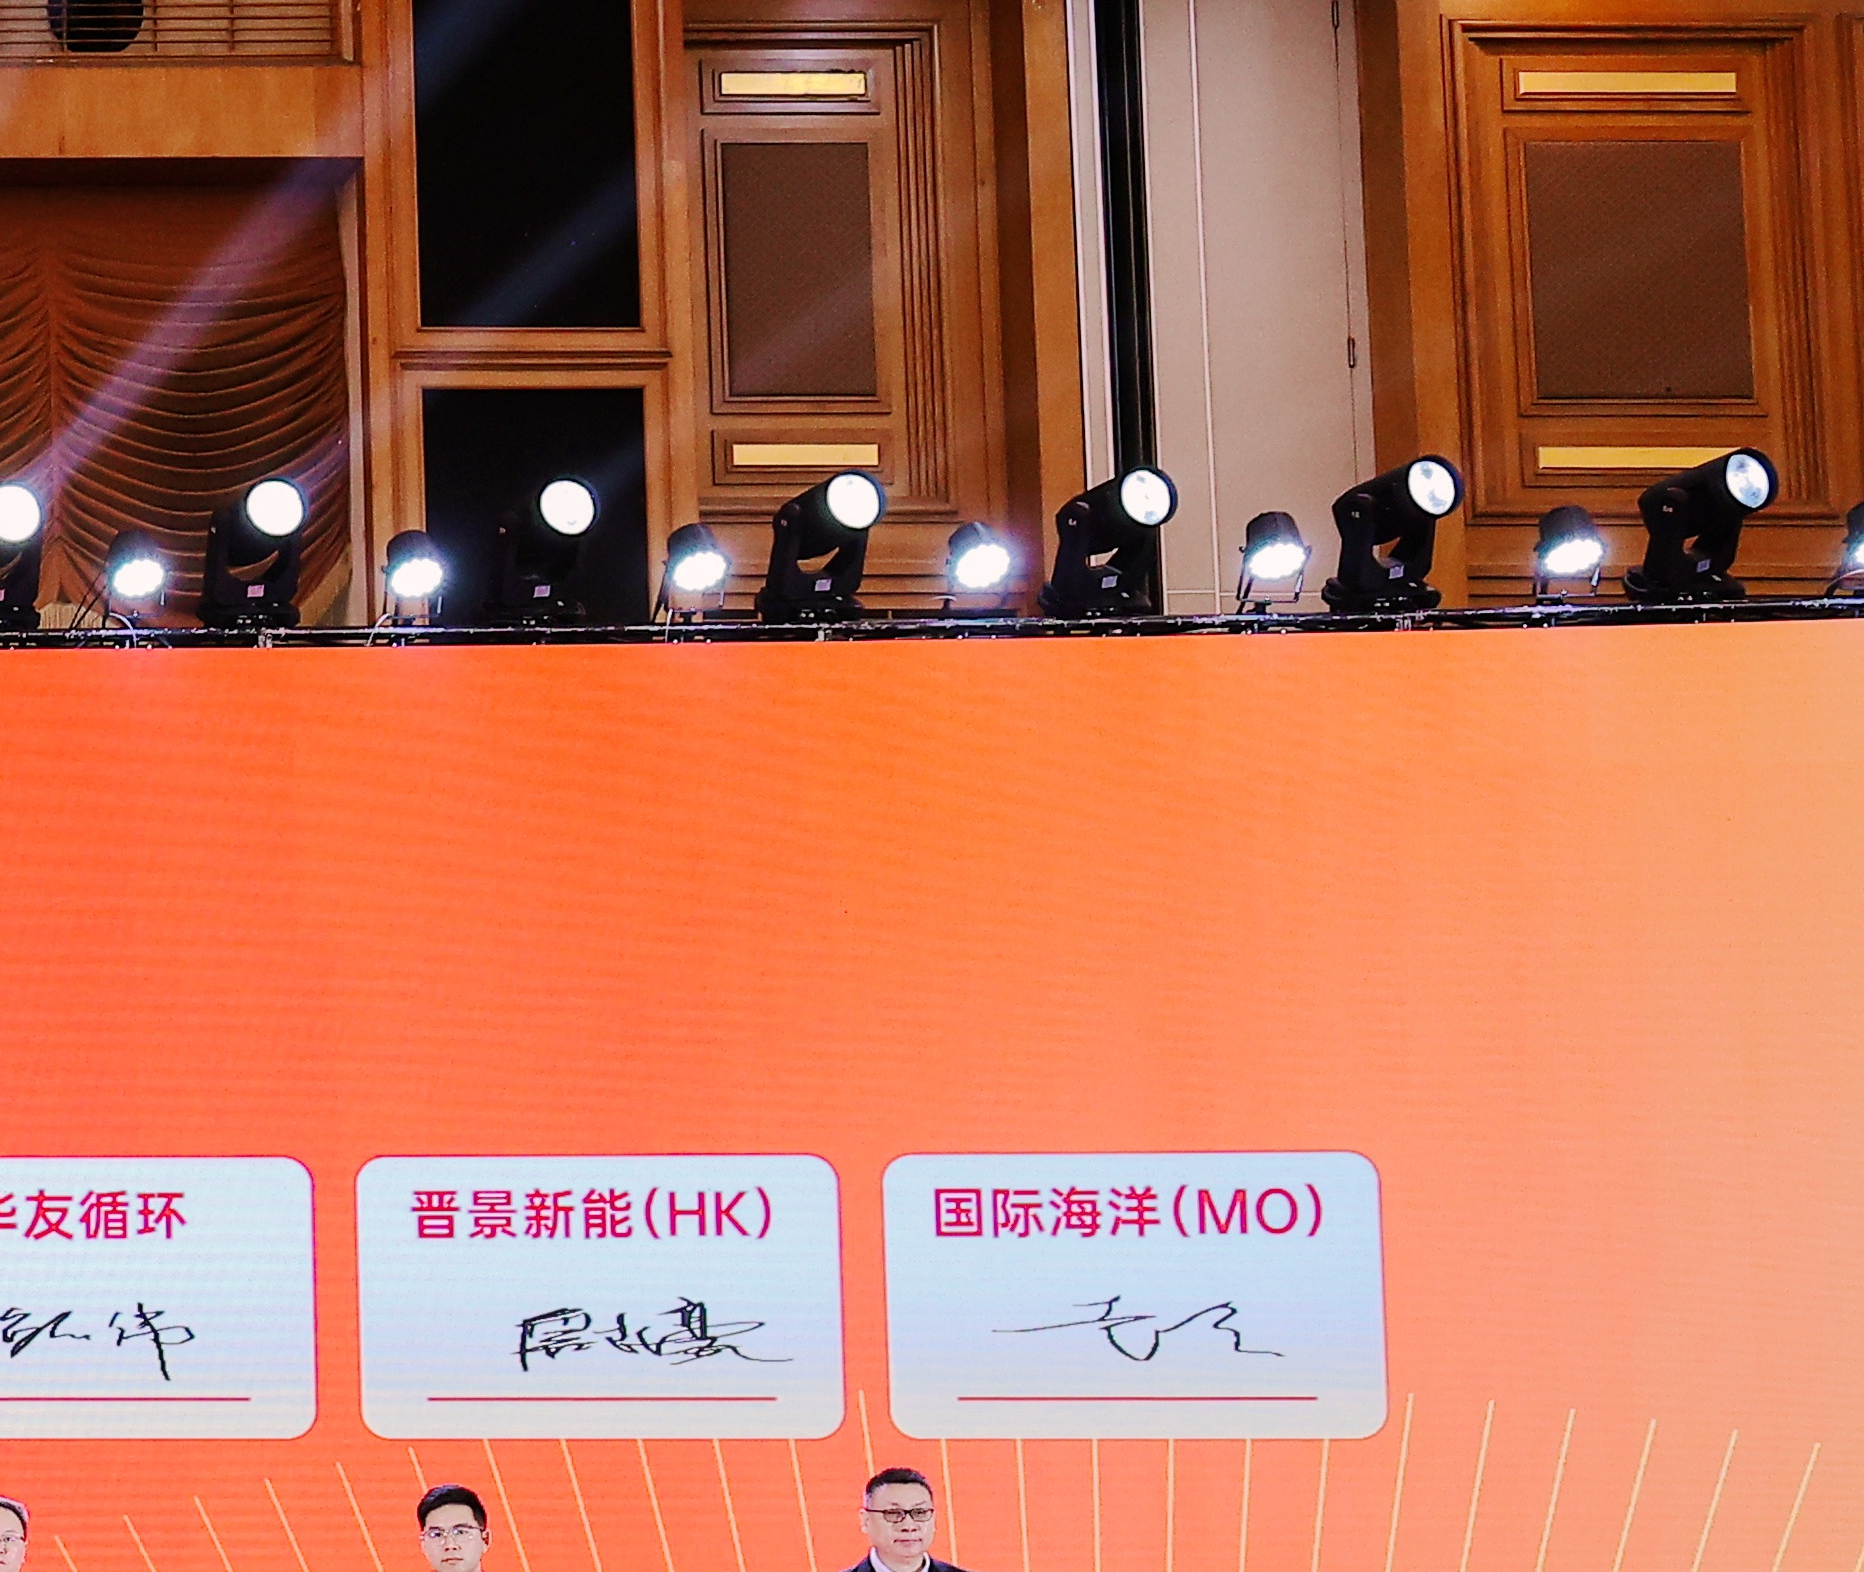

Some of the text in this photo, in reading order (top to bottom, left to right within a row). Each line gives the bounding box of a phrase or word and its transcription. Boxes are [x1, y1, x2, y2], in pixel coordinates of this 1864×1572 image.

[410, 1187, 772, 1240] 晋景新能(HK)
[934, 1184, 1323, 1239] 国际海洋(MO)
